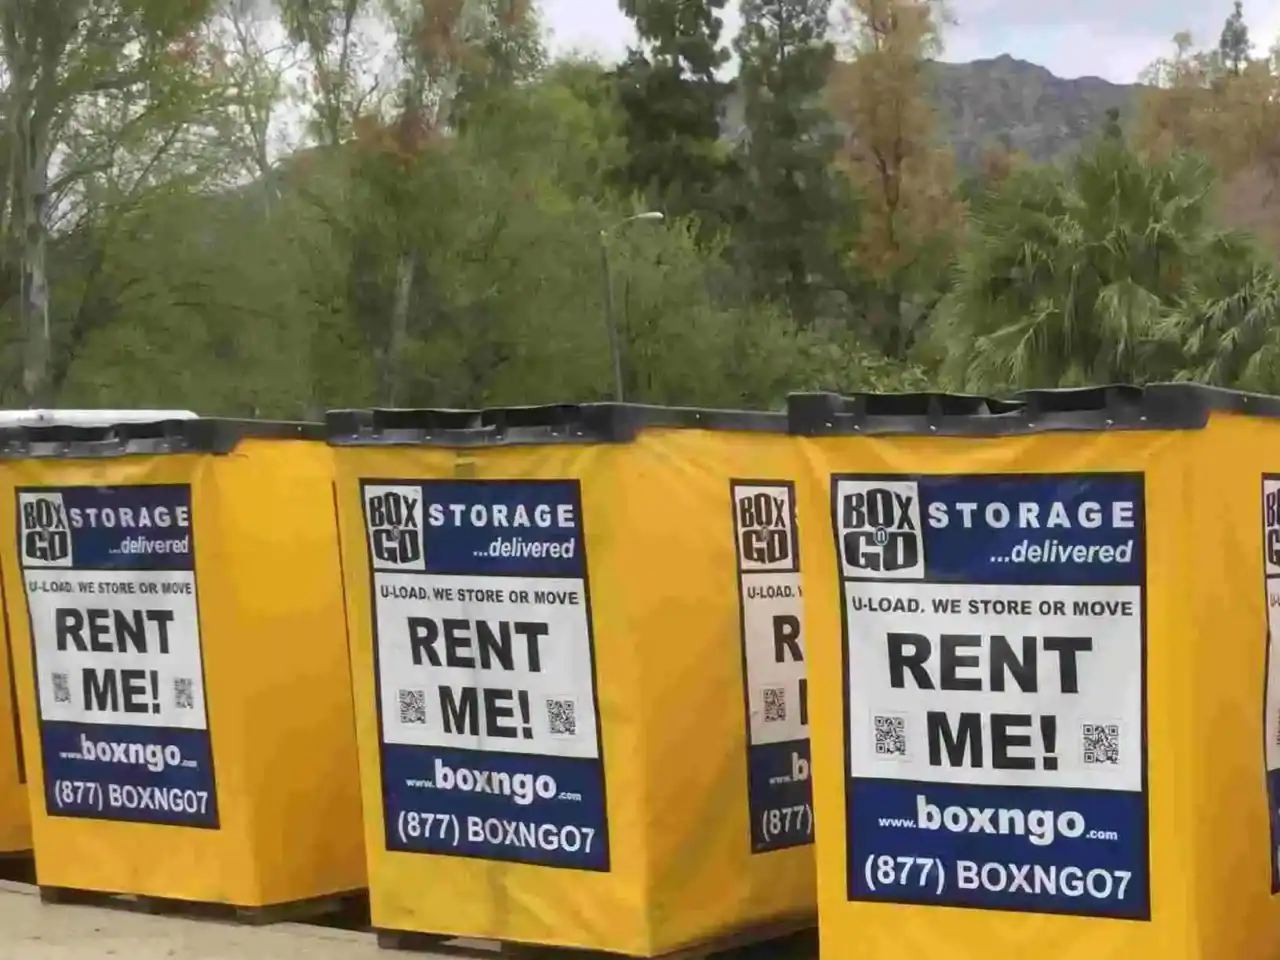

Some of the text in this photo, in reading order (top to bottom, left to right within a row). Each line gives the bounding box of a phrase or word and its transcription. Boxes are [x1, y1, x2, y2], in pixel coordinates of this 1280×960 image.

[24, 498, 66, 530] BOX
[72, 505, 190, 528] STORAGE
[370, 492, 418, 528] BOX
[428, 504, 575, 528] STORAGE
[739, 493, 785, 528] BOX
[843, 488, 915, 531] BOX
[928, 501, 1134, 529] STORAGE
[25, 531, 68, 562] GO
[373, 529, 420, 564] GO
[472, 536, 574, 559] ...delivered
[742, 529, 789, 564] GO
[844, 530, 918, 572] GO
[990, 540, 1133, 564] ...delivered
[78, 582, 96, 594] WE
[98, 582, 135, 595] STORE
[138, 582, 159, 595] OR
[162, 582, 192, 596] MOVE
[380, 585, 579, 605] U-LOAD. WE STORE OR MOVE
[748, 584, 796, 600] U-LOAD.
[852, 596, 1133, 617] U-LOAD. WE STORE OR MOVE
[56, 608, 174, 654] RENT
[407, 616, 548, 672] RENT
[886, 632, 1092, 694] RENT
[82, 668, 161, 714] ME!
[438, 685, 534, 740] ME!
[926, 711, 1058, 771] ME!
[54, 780, 208, 815] (877) BOXNGO7
[398, 810, 595, 853] (877) BOXNGO7
[762, 804, 813, 842] (877)
[878, 794, 1118, 846] www.boxngo.com
[864, 854, 1132, 900] (877) BOXNGO7
